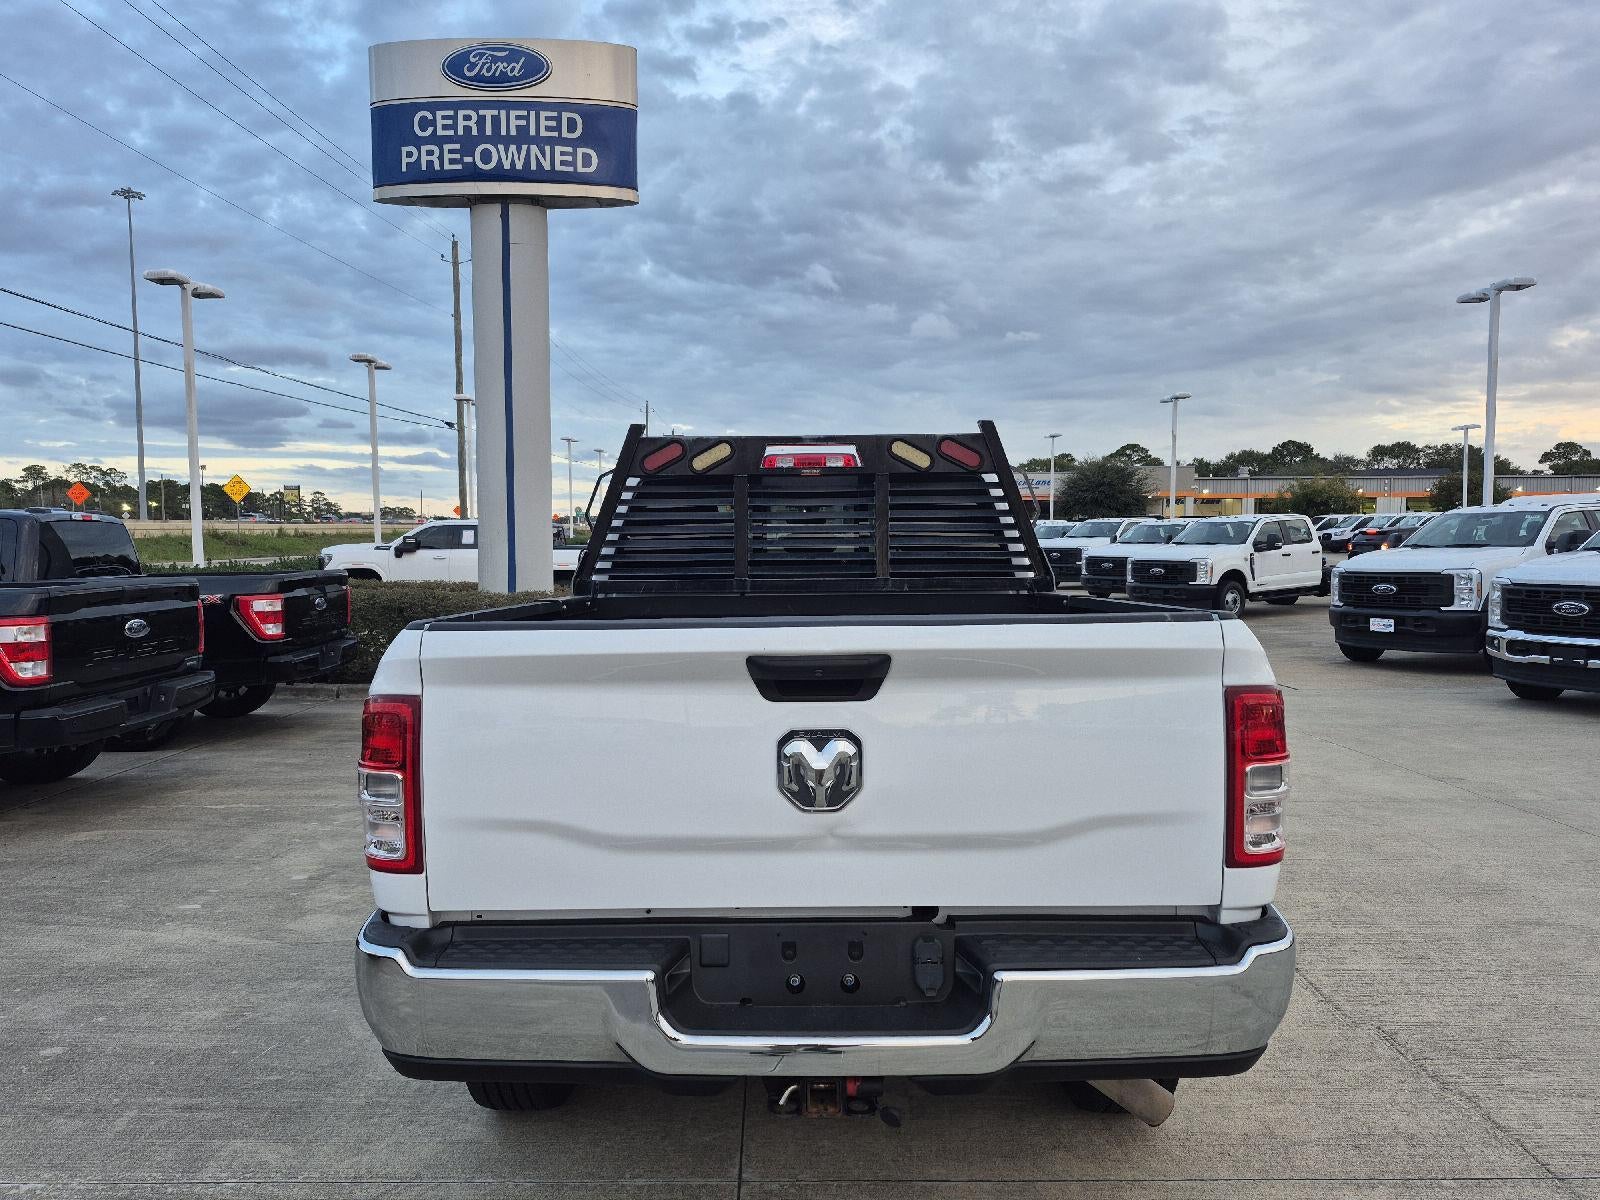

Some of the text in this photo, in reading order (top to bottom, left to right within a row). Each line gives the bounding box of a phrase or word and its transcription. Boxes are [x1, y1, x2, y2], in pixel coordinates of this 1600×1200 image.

[463, 49, 525, 77] Ford
[413, 109, 584, 139] CERTIFIED
[401, 143, 599, 174] PRE-OWNED
